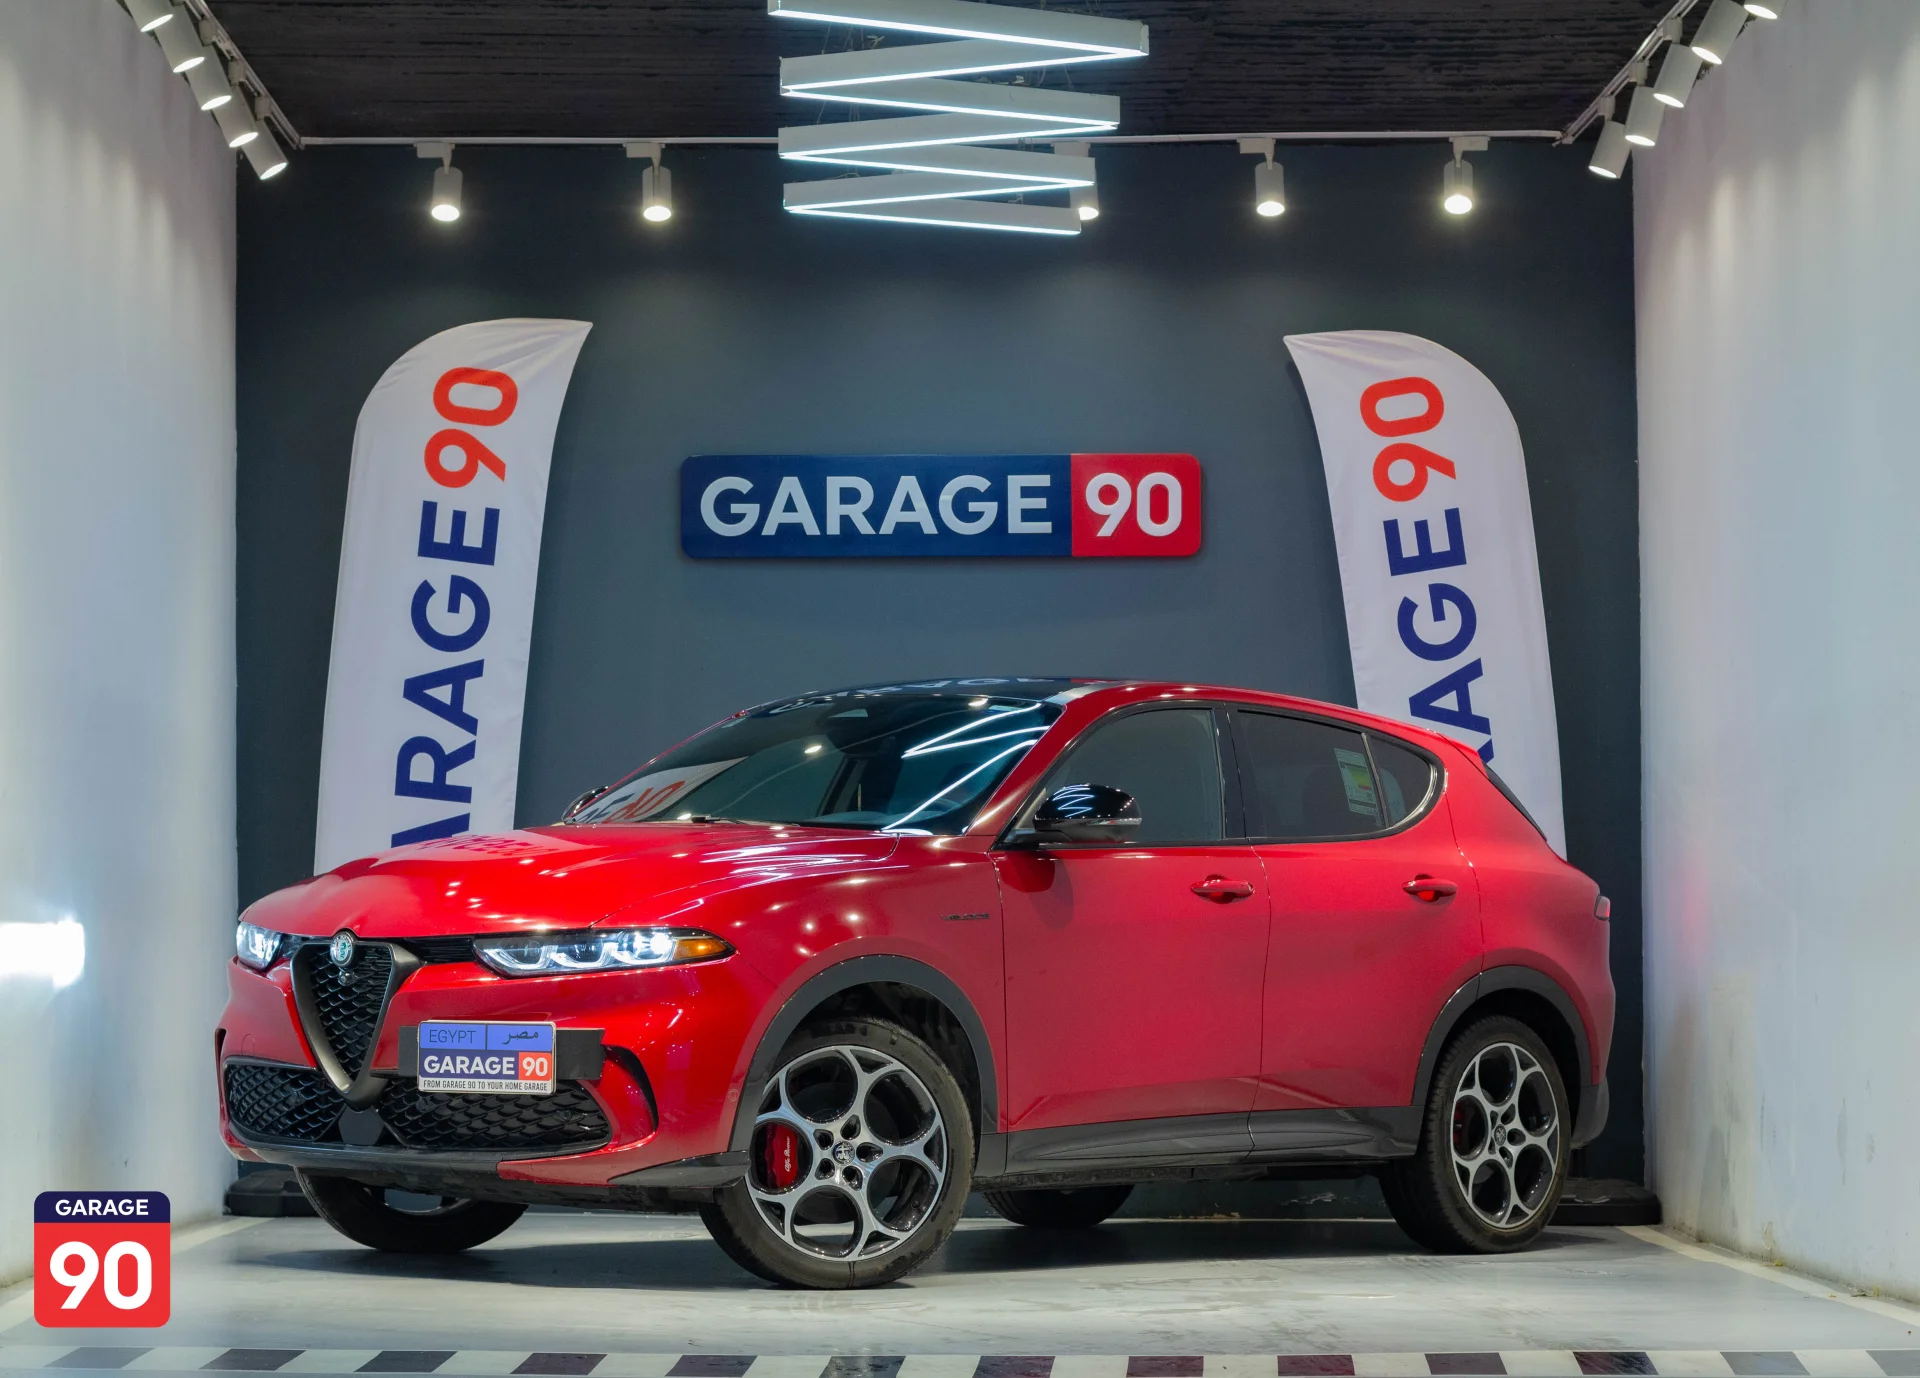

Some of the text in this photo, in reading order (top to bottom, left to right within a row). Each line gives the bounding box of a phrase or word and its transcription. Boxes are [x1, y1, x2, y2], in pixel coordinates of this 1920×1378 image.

[699, 472, 1183, 537] GARAGE 90
[428, 1029, 477, 1044] EGYPT
[501, 1029, 539, 1045] مصر
[423, 1055, 548, 1077] GARAGE 90
[423, 1079, 548, 1091] FROM GARAGE 90 TO YOUR HOME GARAGE
